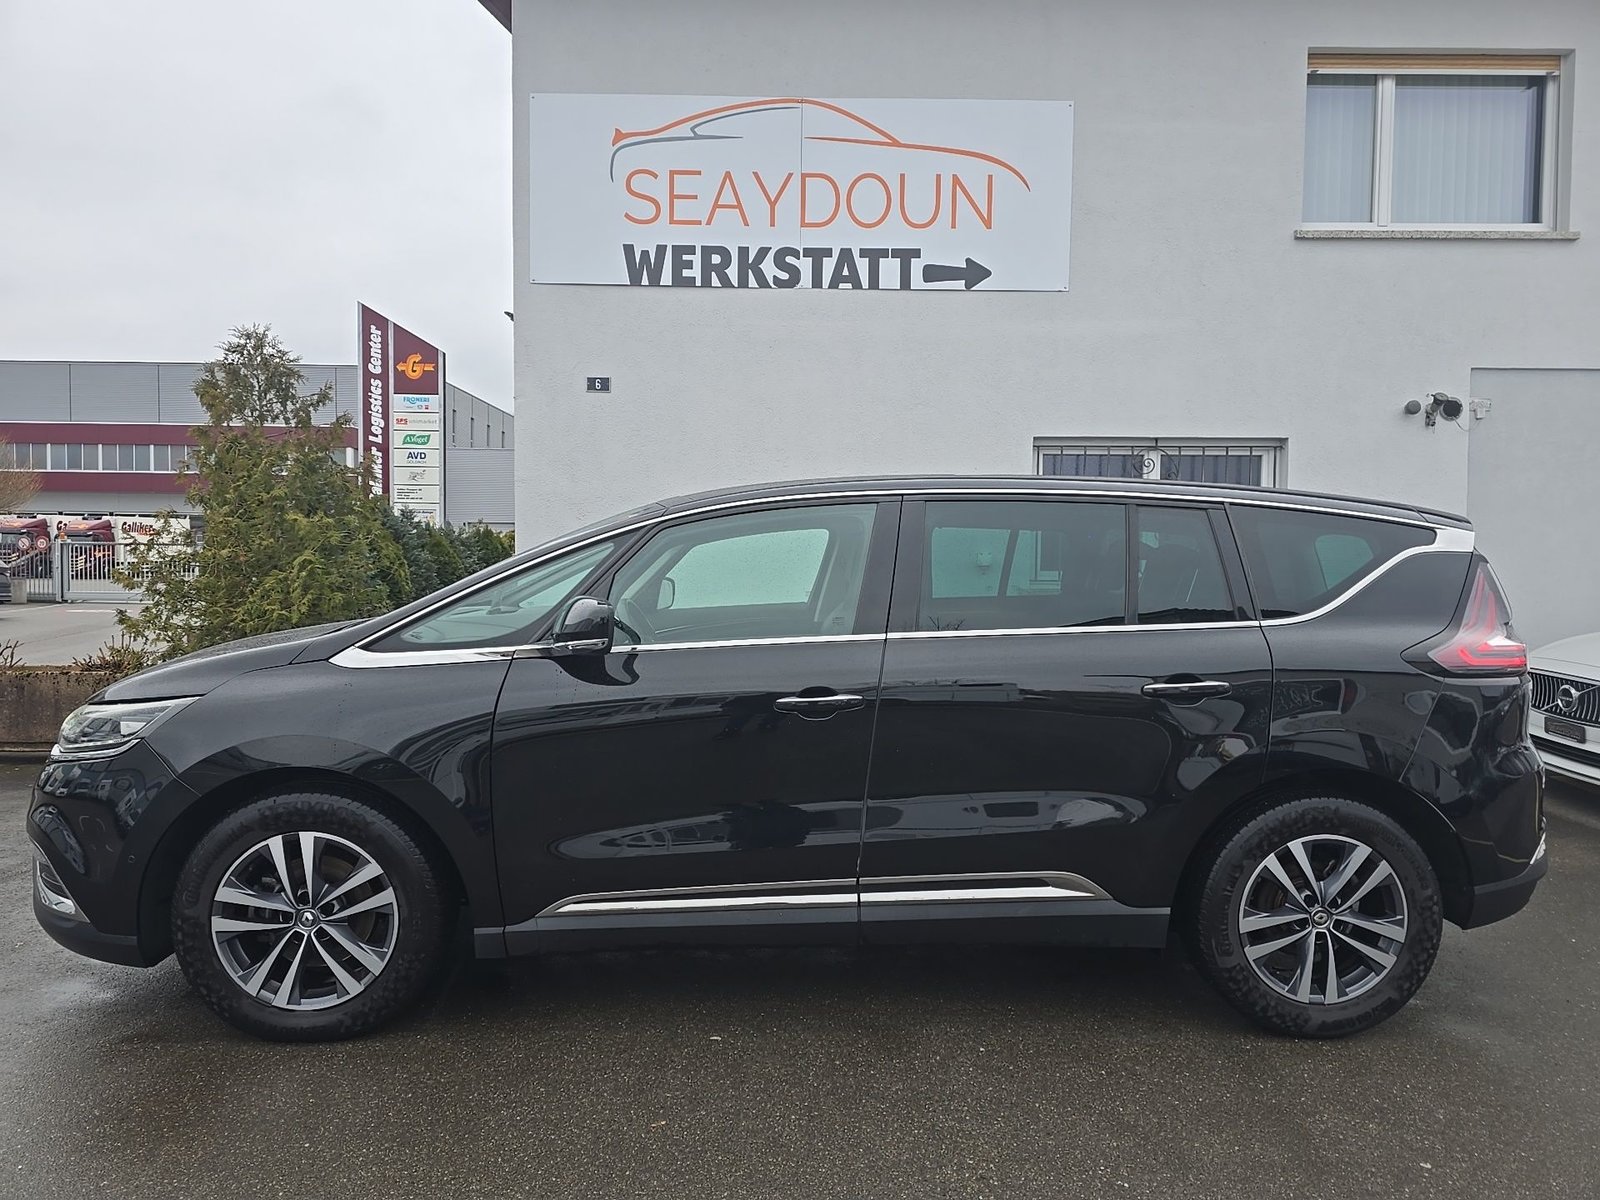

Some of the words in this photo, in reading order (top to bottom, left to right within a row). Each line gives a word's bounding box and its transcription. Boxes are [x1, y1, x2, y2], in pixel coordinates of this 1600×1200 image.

[623, 167, 994, 231] SEAYDOUN
[622, 243, 922, 290] WERKSTATT
[368, 324, 382, 374] Center
[595, 378, 602, 390] 6
[368, 378, 384, 443] Logistics
[407, 451, 427, 460] AVD
